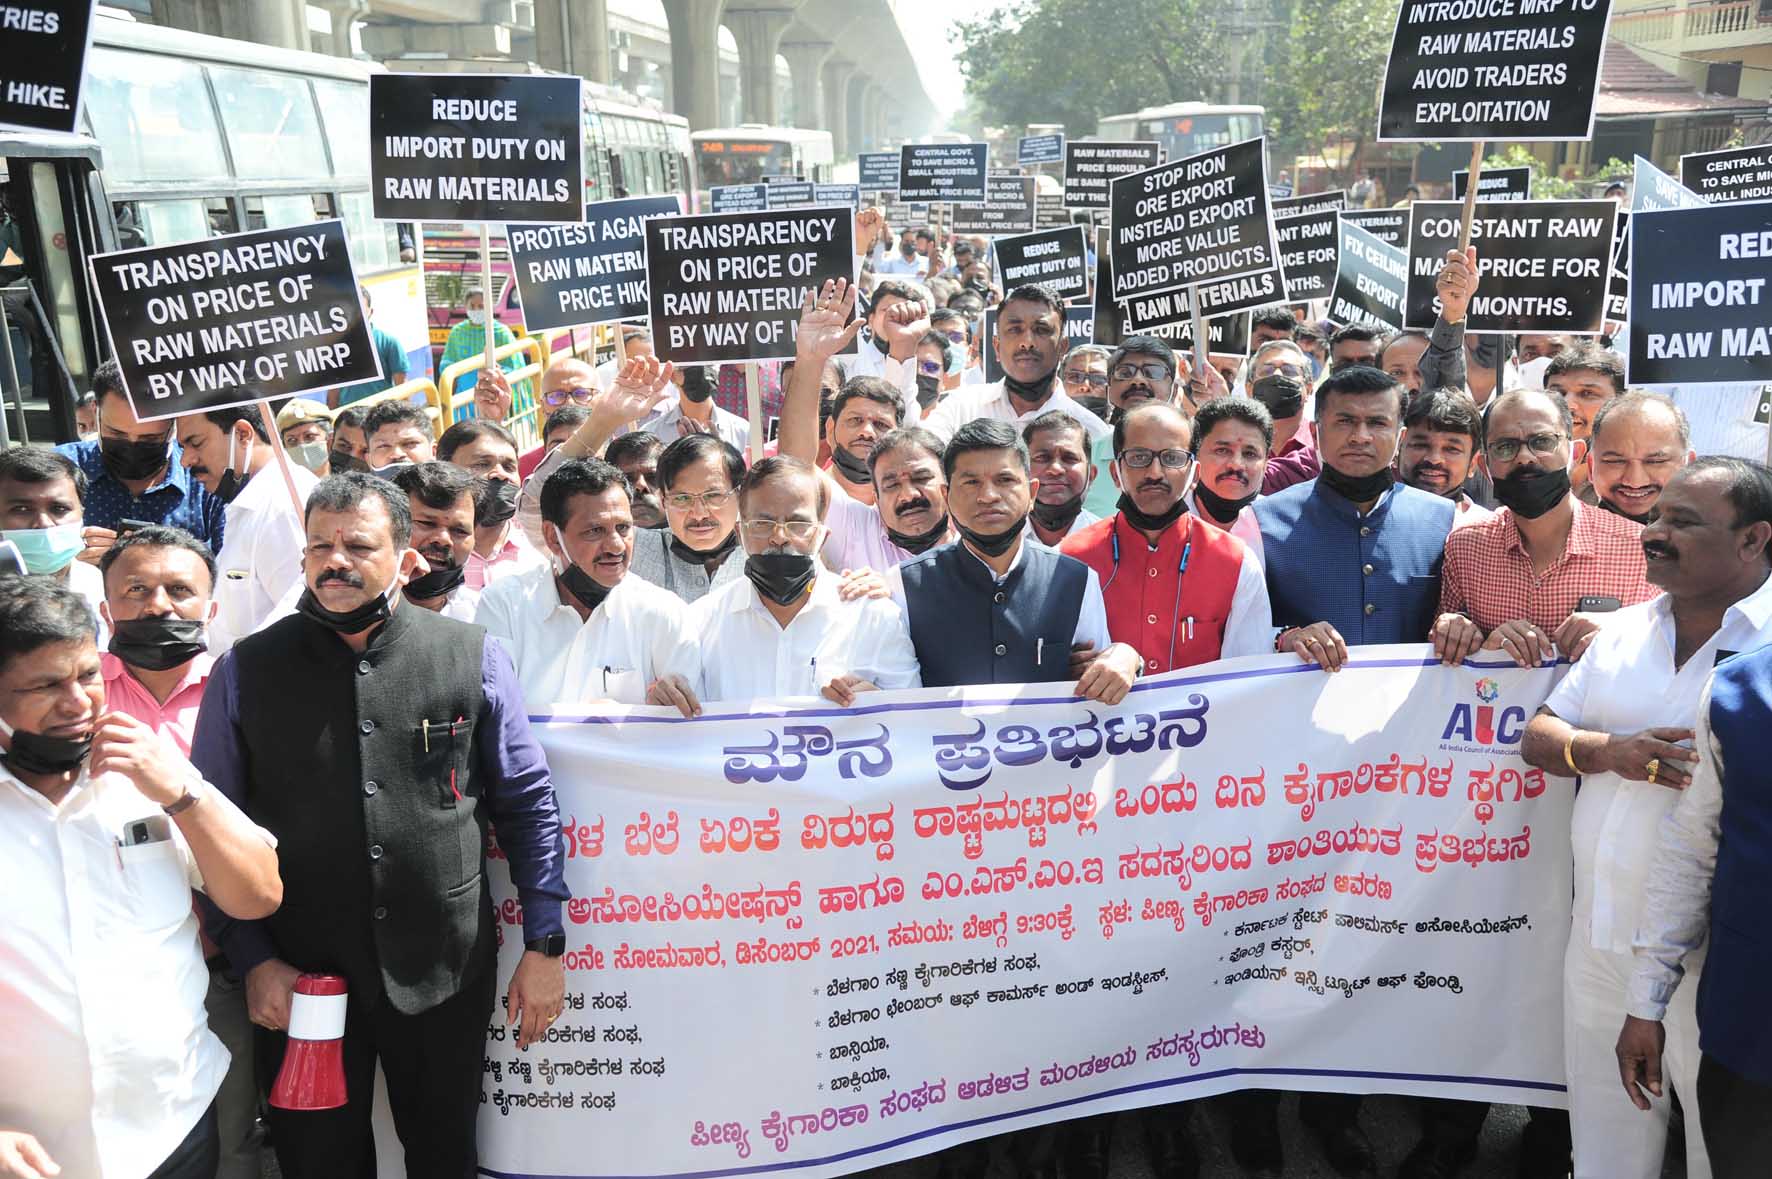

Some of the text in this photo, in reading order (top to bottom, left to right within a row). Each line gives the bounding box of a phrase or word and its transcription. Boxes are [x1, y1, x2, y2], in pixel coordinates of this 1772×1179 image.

[1408, 0, 1514, 23] INTRODUCE
[1519, 0, 1560, 15] MRP
[1418, 26, 1575, 55] RAW MATERIALS
[1412, 63, 1567, 89] AVOID TRADERS
[8, 81, 70, 110] HIKE.
[433, 99, 517, 121] REDUCE
[1415, 100, 1550, 123] EXPLOITATION
[386, 136, 565, 160] IMPORT DUTY ON
[1074, 149, 1150, 158] RAW MATERIALS
[1077, 164, 1105, 172] PRICE
[1144, 155, 1226, 193] STOP IRON
[1707, 155, 1765, 172] CENTRAL
[385, 177, 569, 201] RAW MATERIALS
[1066, 179, 1079, 187] BE
[1081, 178, 1107, 187] SAME
[1702, 172, 1754, 188] TO SAVE
[1066, 193, 1107, 202] OUT THE
[1136, 195, 1167, 217] ORE
[1171, 176, 1235, 208] EXPORT
[659, 218, 836, 250] TRANSPARENCY
[1120, 214, 1185, 244] INSTEAD
[1190, 196, 1256, 225] EXPORT
[1302, 221, 1332, 239] RAW
[1547, 218, 1603, 238] RAW
[512, 222, 595, 252] PROTEST
[1023, 241, 1060, 257] REDUCE
[1137, 225, 1240, 263] MORE VALUE
[112, 234, 327, 291] TRANSPARENCY
[680, 252, 817, 282] ON PRICE OF
[1006, 256, 1081, 279] IMPORT DUTY ON
[1116, 245, 1271, 291] ADDED PRODUCTS.
[1308, 247, 1336, 264] FOR
[1344, 235, 1408, 282] FIX CEILING
[1477, 258, 1600, 277] PRICE FOR
[529, 257, 571, 283] RAW
[147, 275, 313, 324] ON PRICE OF
[559, 285, 615, 312] PRICE
[663, 291, 711, 316] RAW
[1135, 274, 1275, 321] RAW MTERIALS
[1356, 273, 1399, 309] EXPORT
[1651, 279, 1765, 309] IMPORT
[1334, 297, 1362, 323] RAW
[1472, 297, 1572, 316] MONTHS.
[132, 307, 348, 365] RAW MATERIALS
[669, 325, 698, 348] BY
[703, 322, 749, 346] WAY
[755, 320, 784, 344] OF
[1647, 332, 1712, 359] RAW
[148, 343, 350, 400] BY WAY OF MRP
[723, 694, 1210, 790] ಮೌನ ಪ್ರತಿಭಟನೆ
[624, 810, 680, 856] ಬೆಲೆ
[700, 808, 781, 854] ಏರಿಕೆ
[1115, 772, 1197, 818] ಒಂದು
[1215, 766, 1266, 808] ದಿನ
[1283, 753, 1454, 822] ಕೈಗಾರಿಕೆಗಳ
[1467, 760, 1546, 825] ಸ್ಥಗಿತ
[818, 872, 905, 914] ಹಾಗೂ
[1119, 837, 1252, 891] ಸದಸ್ಯರಿಂದ
[1267, 818, 1402, 865] ಶಾಂತಿಯುತ
[1415, 825, 1532, 873] ಪ್ರತಿಭಟನೆ
[614, 940, 726, 970] ಸೋಮವಾರ,
[736, 937, 821, 965] ಡಿಸೆಂಬರ್
[888, 918, 954, 948] ಸಮಯ:
[962, 911, 1007, 949] ಬೆಳಿಗ್ಗೆ
[1141, 898, 1185, 932] ಪೀಣ್ಯ
[1193, 887, 1269, 926] ಕೈಗಾರಿಕಾ
[1276, 872, 1328, 901] ಸಂಘದ
[1334, 872, 1392, 900] ಆವರಣ
[1234, 911, 1290, 937] ಕರ್ನಾಟಕ
[1292, 907, 1328, 930] ಸ್ಟೇಟ್
[827, 957, 998, 997] ಬೆಳಗಾಂ ಸಣ್ಣ ಕೈಗಾರಿಕೆಗಳ
[1224, 965, 1287, 987] ಇಂಡಿಯನ್
[828, 1007, 880, 1029] ಬೆಳಗಾಂ
[950, 989, 980, 1009] ಆಫ್
[1055, 977, 1094, 995] ಅಂಡ್
[508, 1057, 532, 1084] ಸಣ್ಣ
[538, 1057, 623, 1085] ಕೈಗಾರಿಕೆಗಳ
[630, 1056, 665, 1077] ಸಂಘ
[493, 1088, 575, 1116] ಕೈಗಾರಿಕೆಗಳ
[581, 1091, 616, 1112] ಸಂಘ
[691, 1022, 1266, 1159] ಪೀಣ್ಯ ಕೈಗಾರಿಕಾ ಸಂಘದ ಆಡಳಿತ ಮಂಡಳಿಯ ಸದಸ್ಯರುಗಳು
